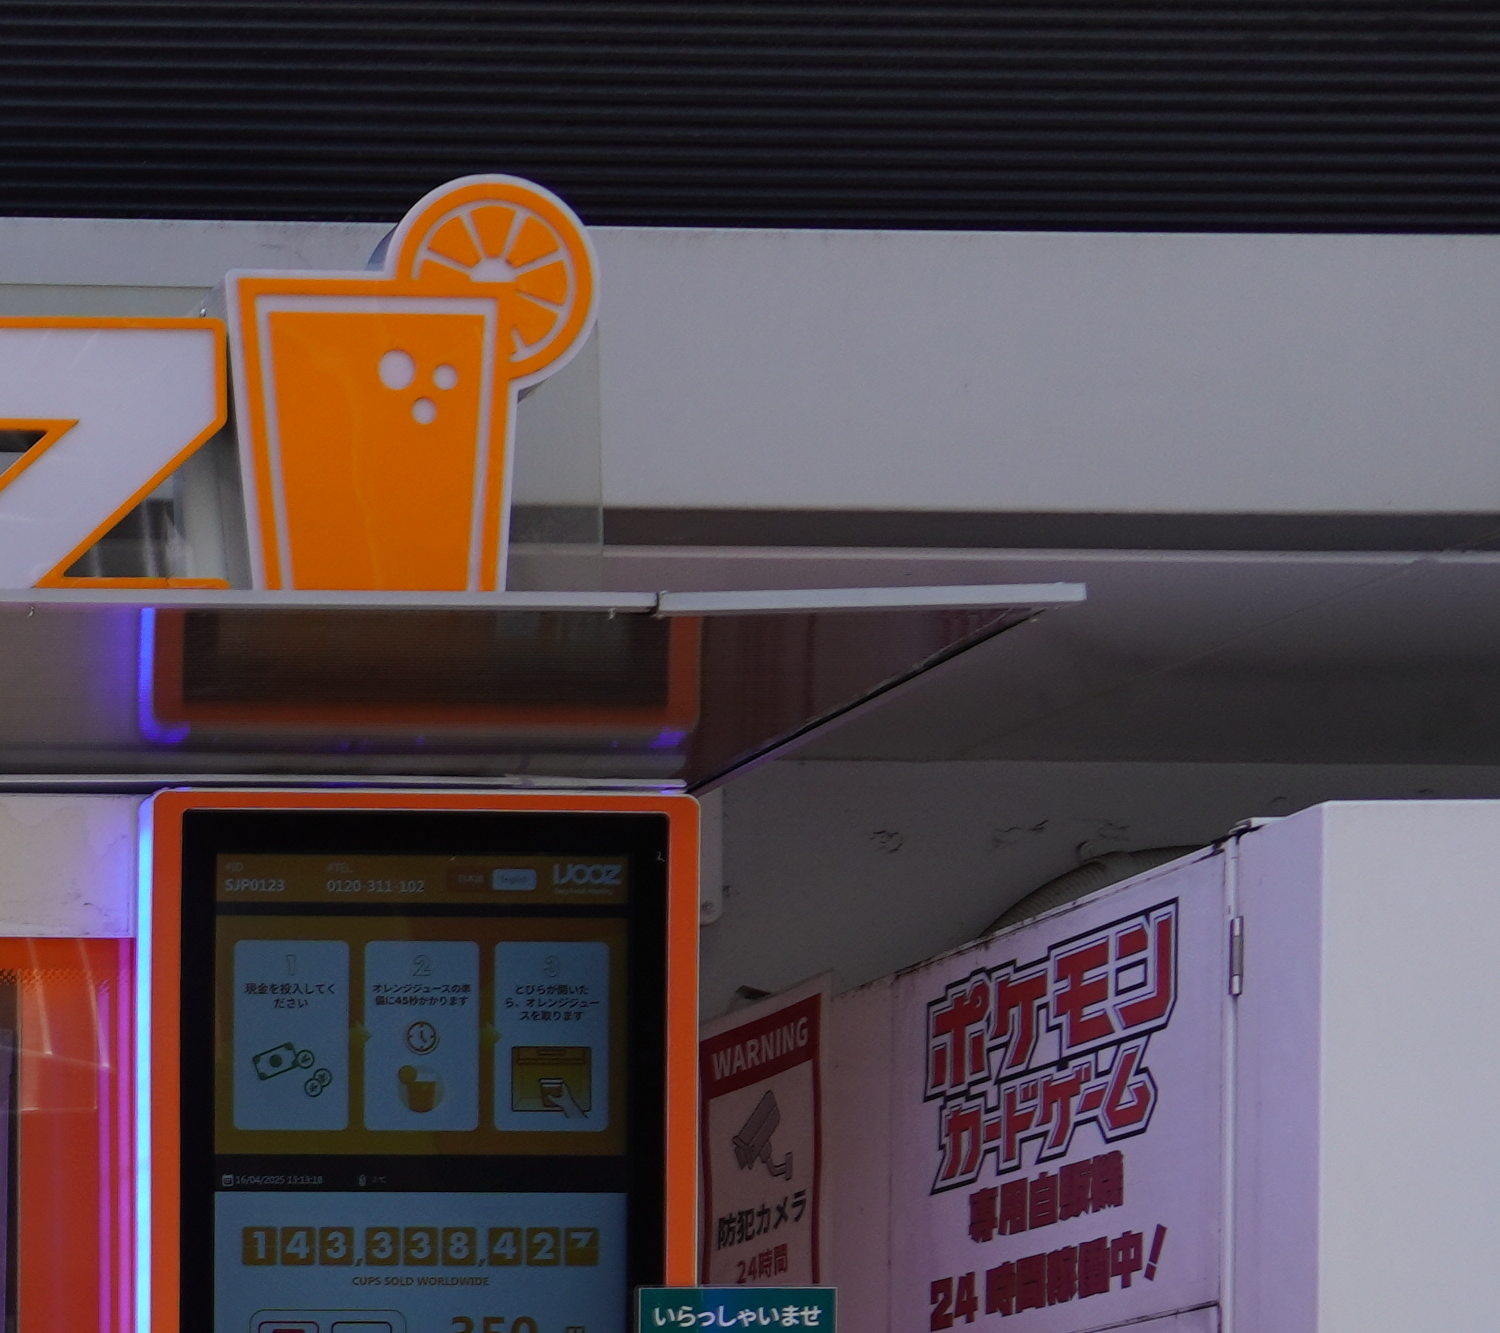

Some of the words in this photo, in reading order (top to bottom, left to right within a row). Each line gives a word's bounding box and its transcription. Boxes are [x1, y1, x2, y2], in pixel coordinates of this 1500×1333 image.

[225, 879, 285, 892] SJP0123
[925, 900, 1178, 1099] ポケモン
[712, 1016, 809, 1081] WARNING
[932, 1040, 1156, 1193] カードゲーム
[717, 1190, 807, 1249] 防犯カメラ
[352, 1277, 381, 1286] CUPS
[384, 1277, 413, 1286] SOLD
[417, 1277, 489, 1286] WORLDWIDE
[737, 1243, 787, 1283] 24時間
[654, 1306, 822, 1327] いらっしゃいませ
